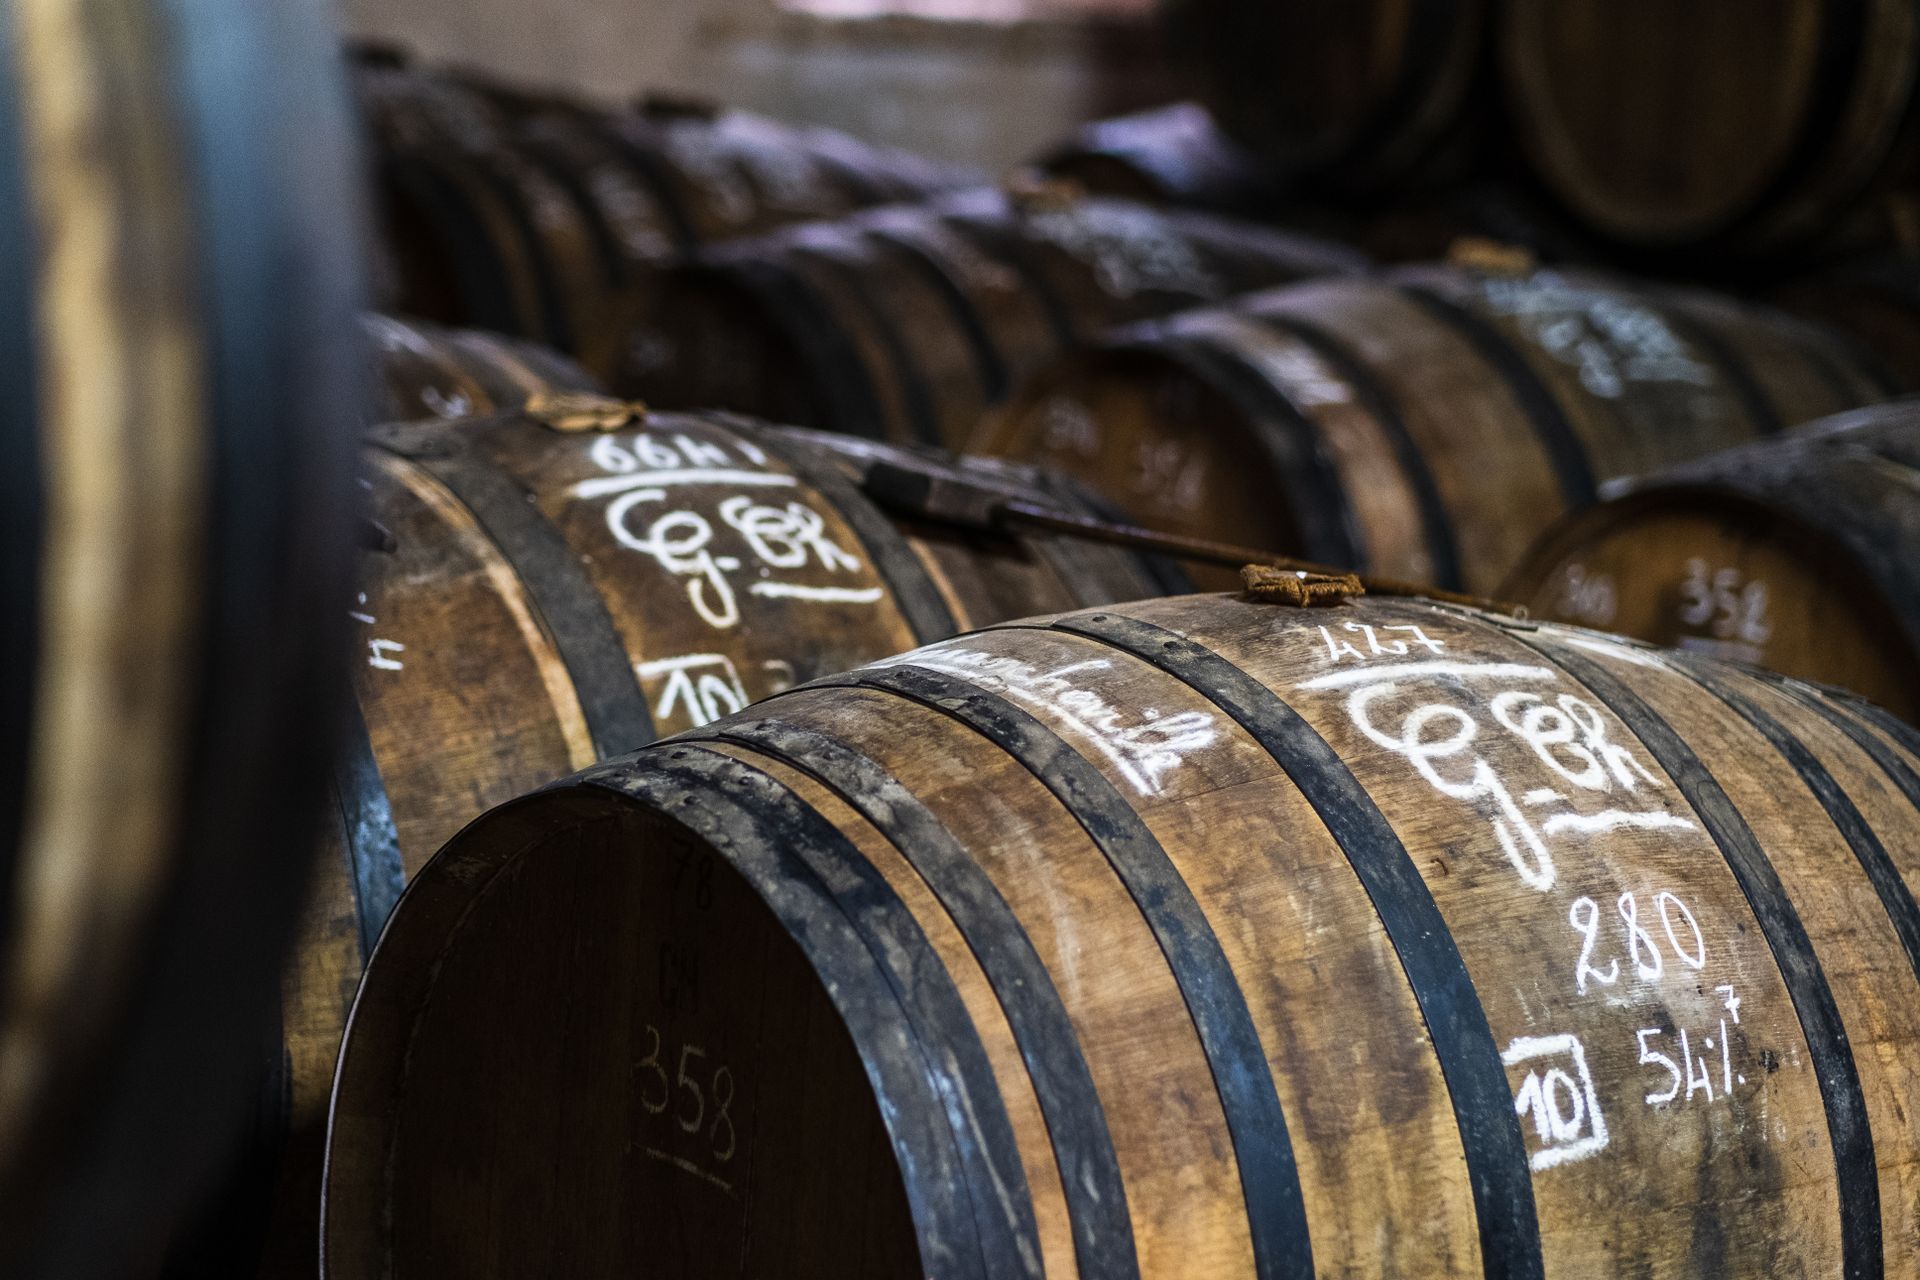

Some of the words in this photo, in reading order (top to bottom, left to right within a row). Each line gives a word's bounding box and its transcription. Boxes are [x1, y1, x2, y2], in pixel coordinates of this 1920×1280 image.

[1318, 624, 1445, 661] 427
[1569, 892, 1705, 995] 280
[634, 1025, 736, 1162] 358
[1515, 1069, 1585, 1144] 10
